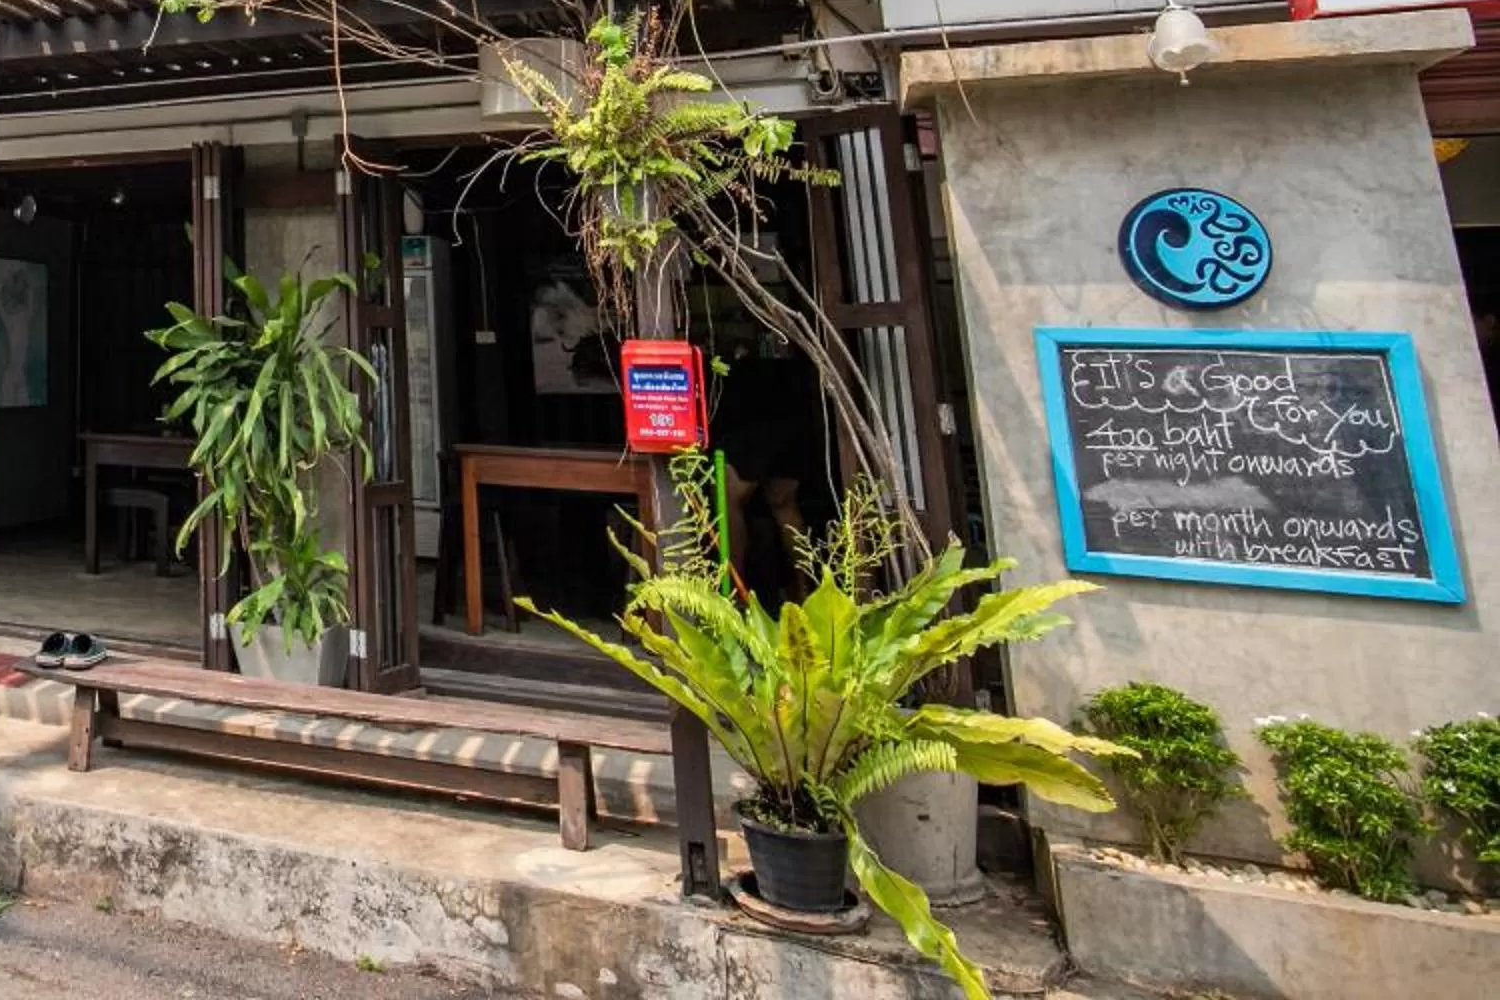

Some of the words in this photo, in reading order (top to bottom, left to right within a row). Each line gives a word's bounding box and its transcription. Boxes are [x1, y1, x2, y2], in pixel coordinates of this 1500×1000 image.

[1201, 354, 1297, 397] Good
[1086, 418, 1156, 447] 400
[1162, 412, 1235, 449] baht
[1320, 400, 1389, 443] You
[1103, 451, 1148, 478] per
[1154, 446, 1226, 486] night
[1228, 450, 1356, 480] onwards
[1111, 509, 1163, 538] per
[1173, 505, 1274, 538] month
[1283, 504, 1420, 544] onwards
[1175, 532, 1238, 560] with
